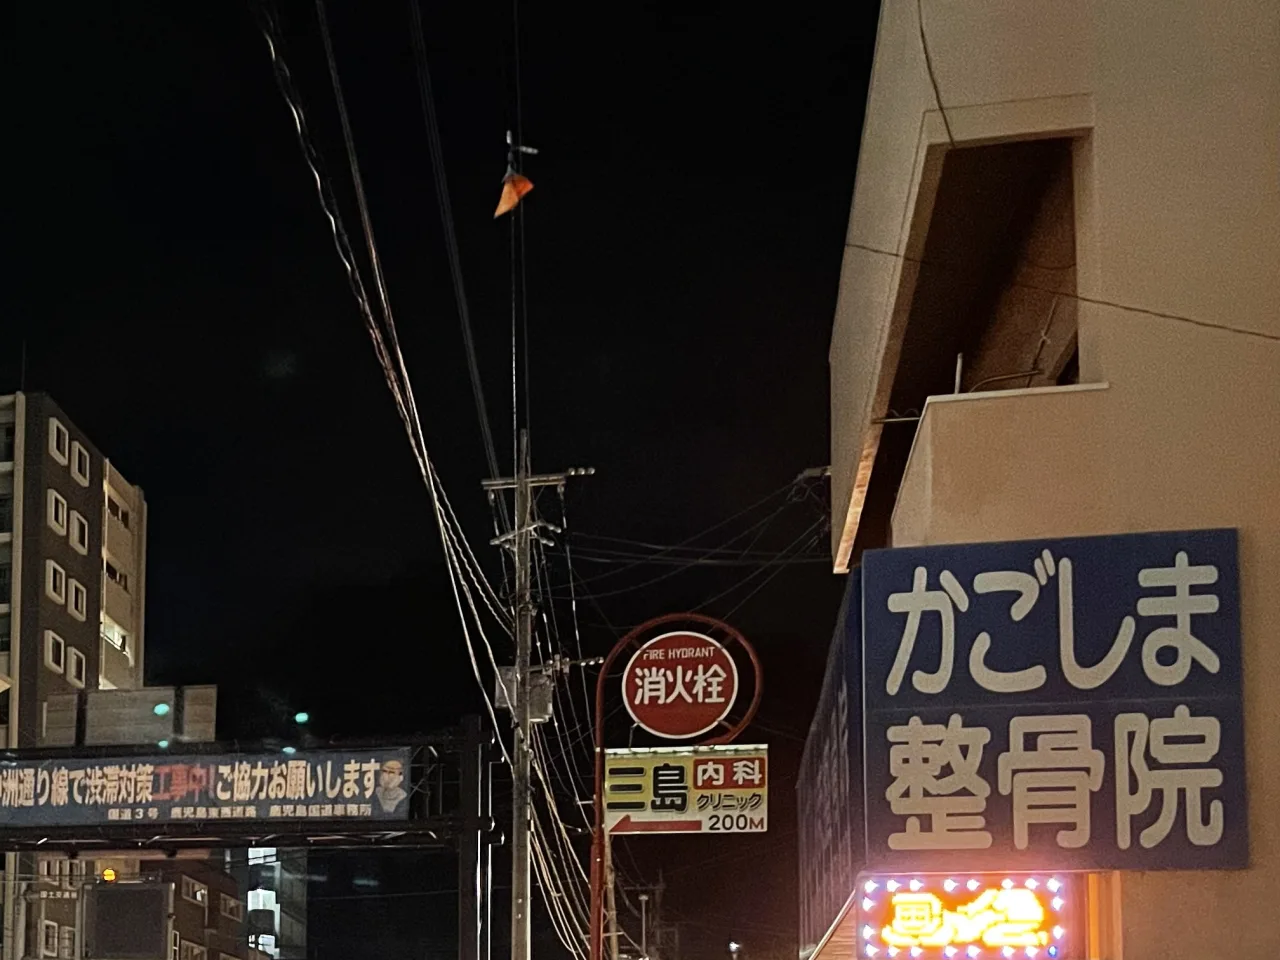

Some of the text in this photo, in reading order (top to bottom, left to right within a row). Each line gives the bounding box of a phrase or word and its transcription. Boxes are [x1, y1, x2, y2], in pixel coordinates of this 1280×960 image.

[886, 548, 1221, 696] かごしま
[643, 646, 716, 660] FIRE HYDRANT
[634, 664, 727, 705] 消火栓
[606, 762, 689, 812] 三島
[696, 759, 762, 787] 内科
[886, 704, 1224, 851] 整骨院
[696, 792, 763, 811] クリニック
[708, 814, 765, 831] 200M
